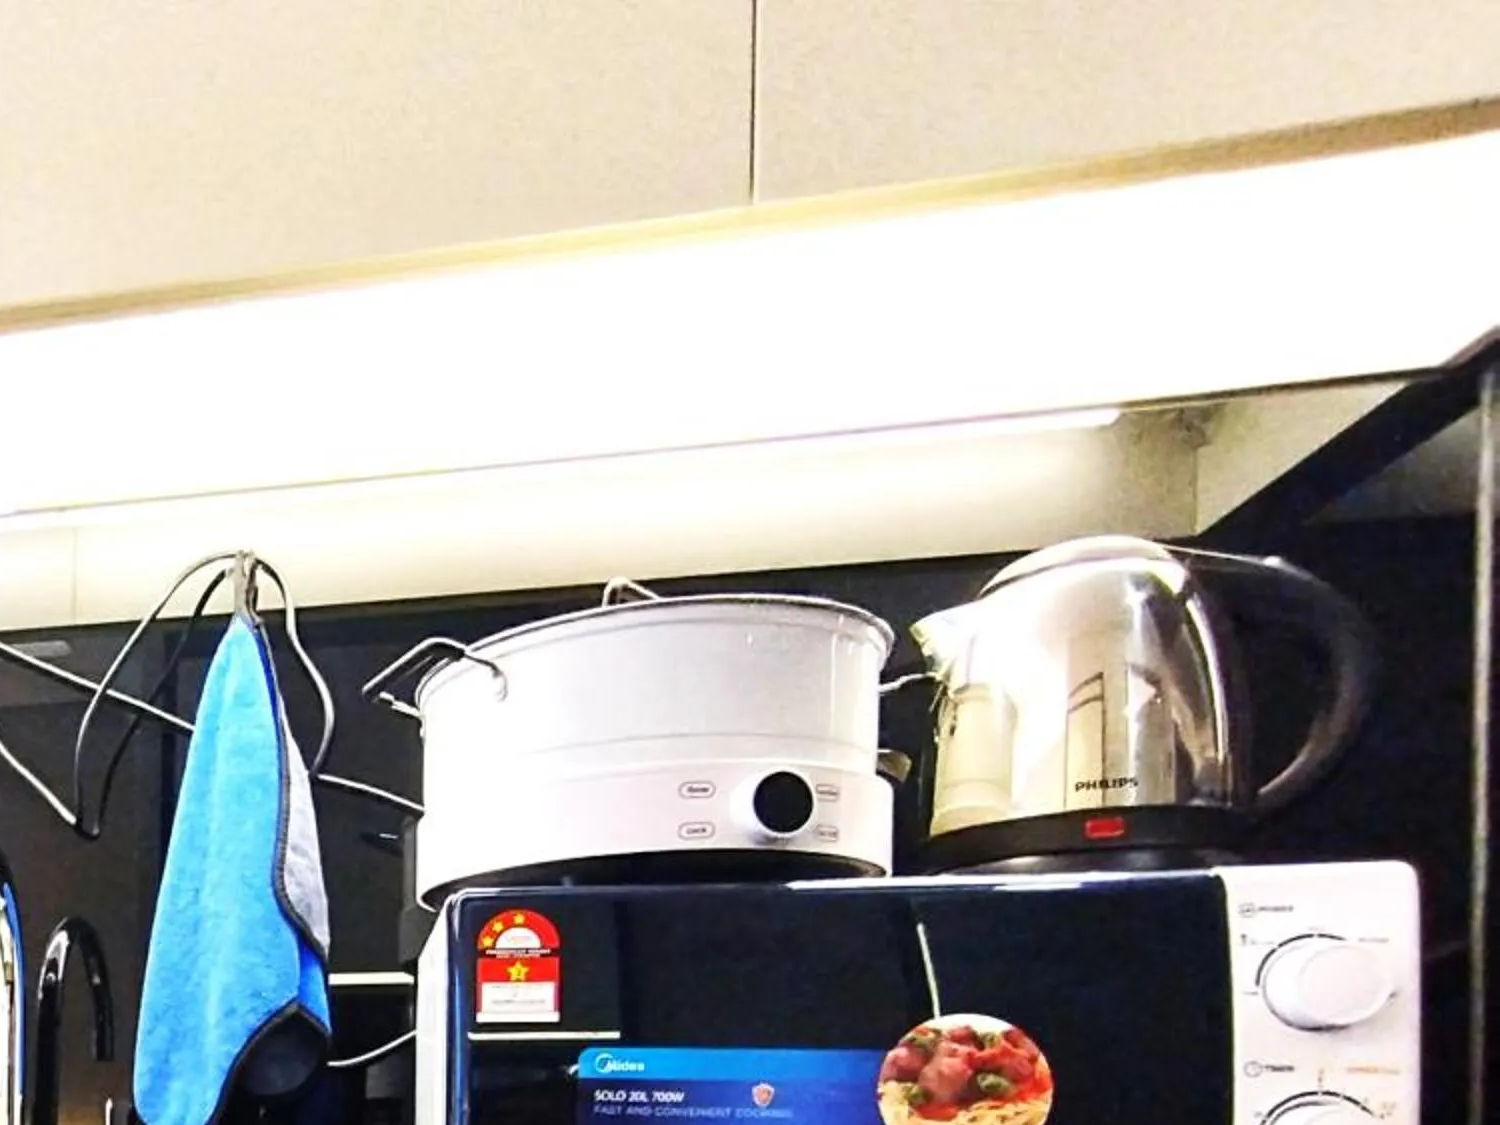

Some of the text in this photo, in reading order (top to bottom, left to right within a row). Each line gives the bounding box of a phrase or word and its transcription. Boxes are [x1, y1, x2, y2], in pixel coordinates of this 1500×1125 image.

[1075, 777, 1139, 792] PHILIPS
[595, 1053, 645, 1074] Midea
[594, 1088, 627, 1102] SOLO
[652, 1090, 685, 1103] 700W
